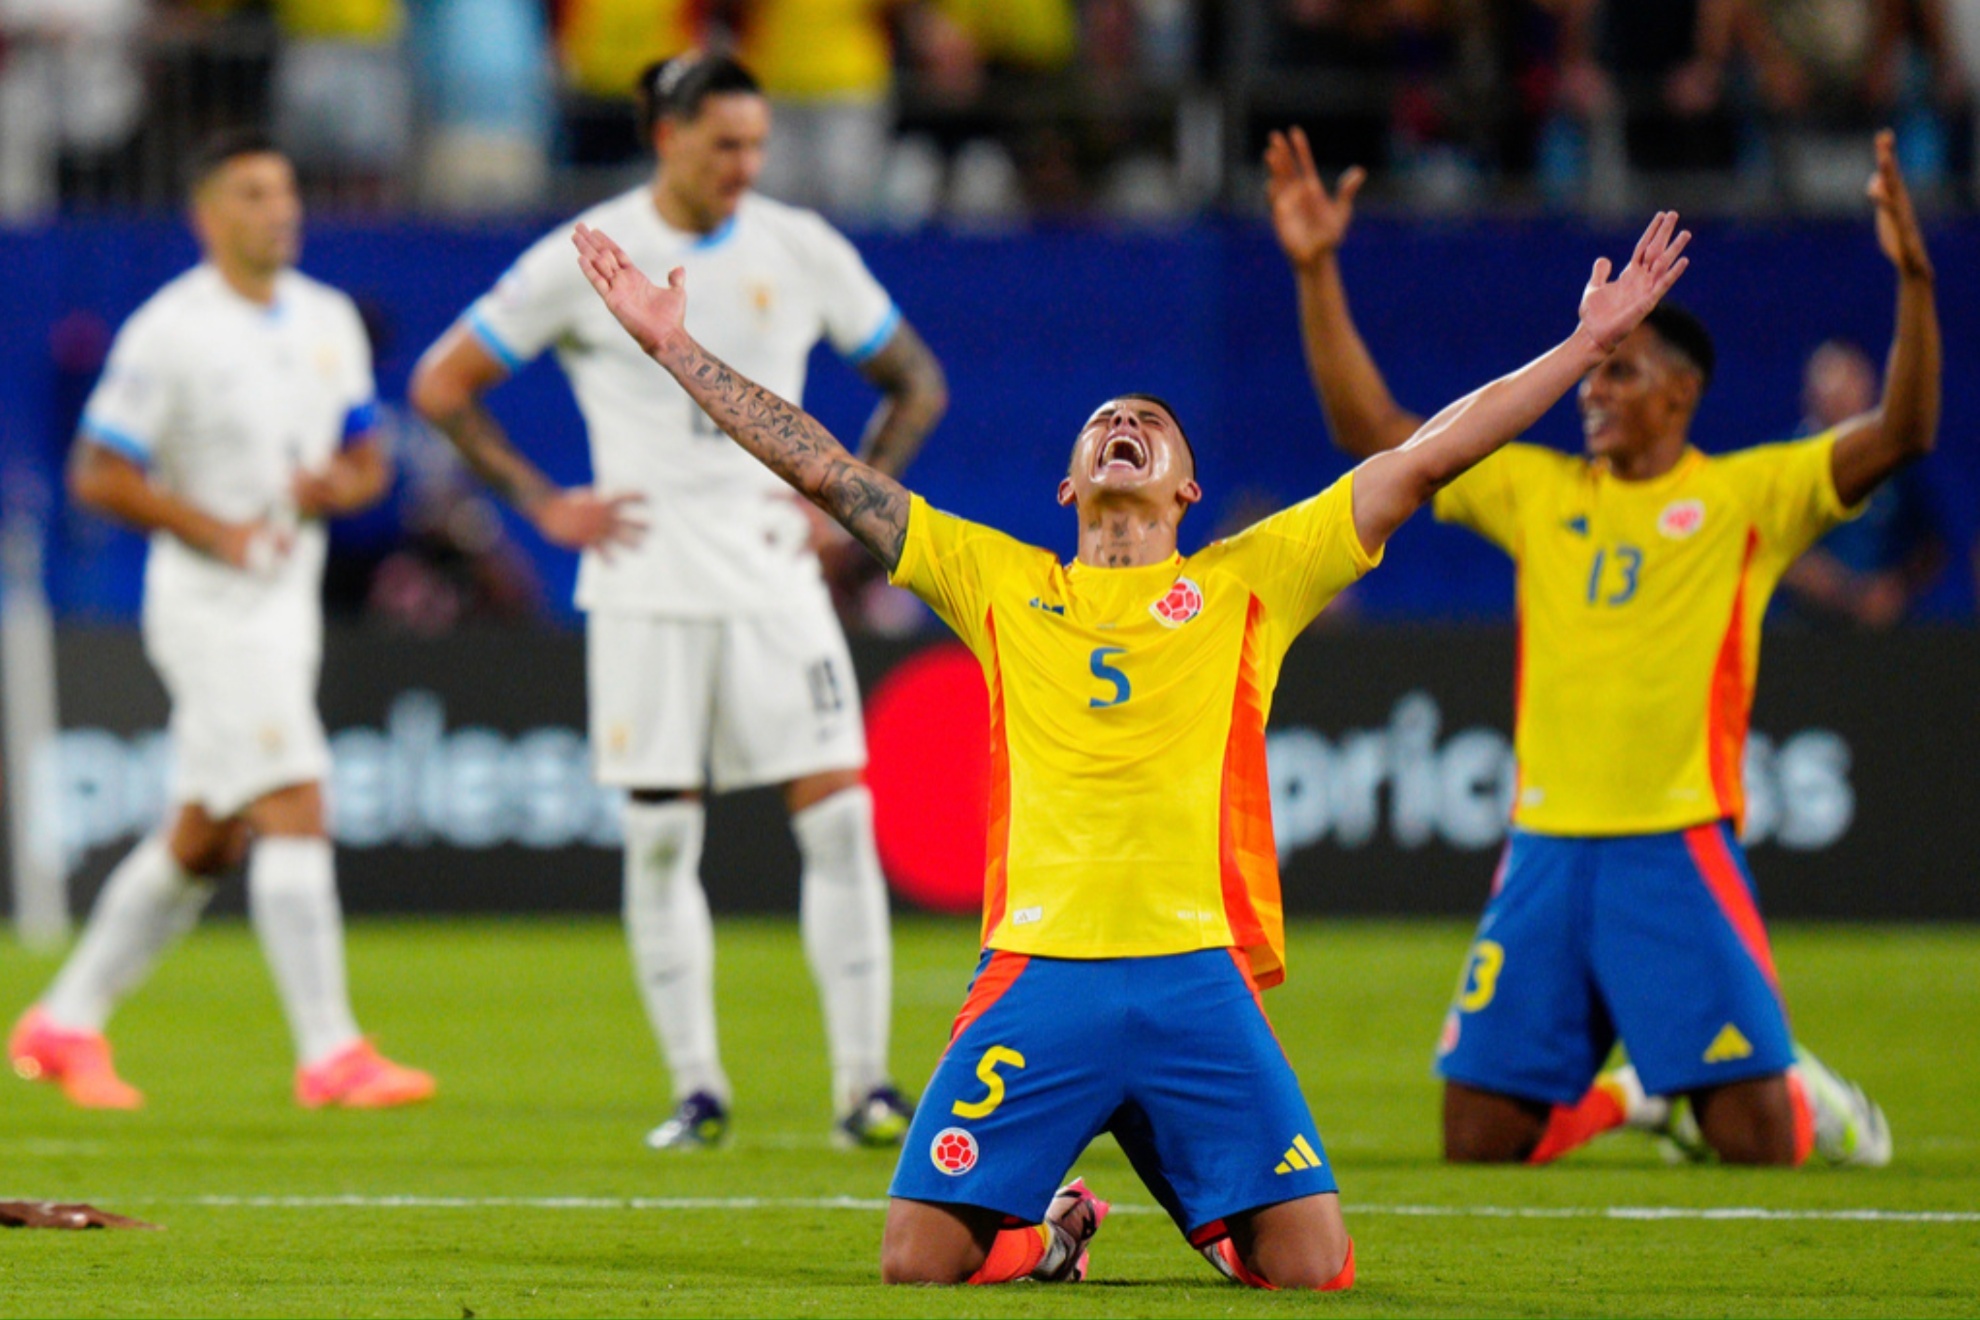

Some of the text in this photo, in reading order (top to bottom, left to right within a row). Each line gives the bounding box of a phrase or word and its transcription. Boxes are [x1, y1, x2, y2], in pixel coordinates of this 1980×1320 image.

[1586, 544, 1644, 607] 13
[1089, 646, 1131, 708] 5
[952, 1045, 1025, 1119] 5
